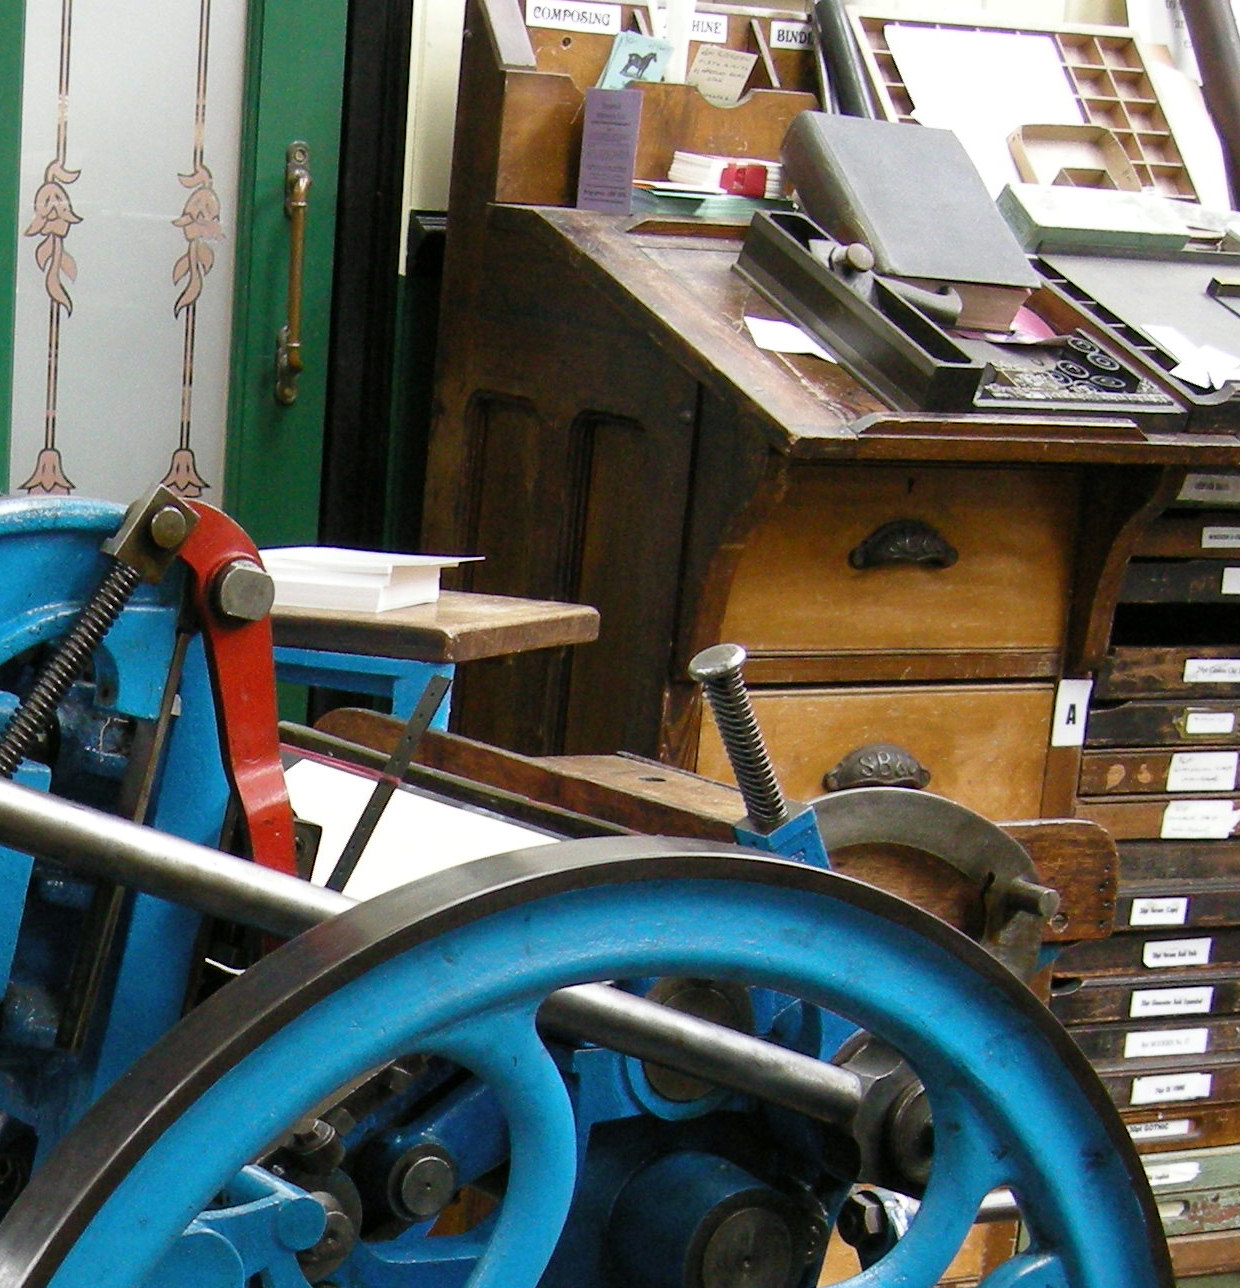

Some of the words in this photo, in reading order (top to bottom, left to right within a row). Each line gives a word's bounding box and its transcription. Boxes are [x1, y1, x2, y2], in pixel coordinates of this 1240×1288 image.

[533, 6, 611, 26] COMPOSING
[691, 20, 722, 34] HINE
[776, 29, 811, 45] BIND
[1065, 703, 1077, 726] A
